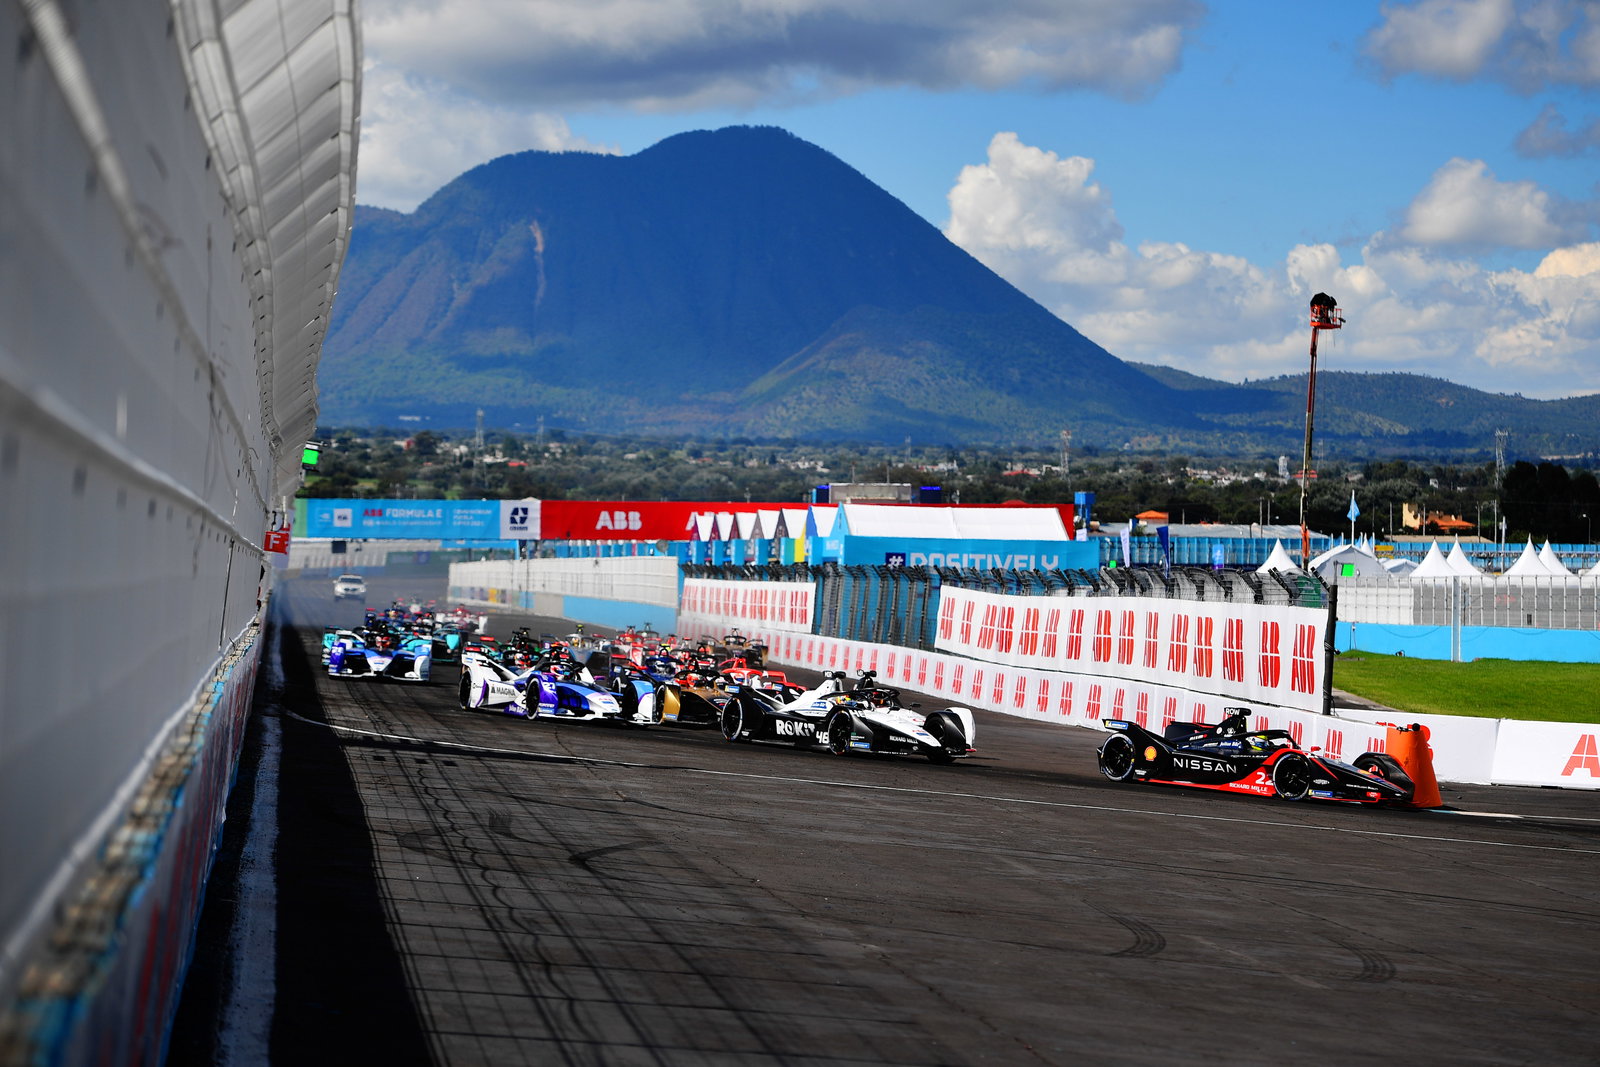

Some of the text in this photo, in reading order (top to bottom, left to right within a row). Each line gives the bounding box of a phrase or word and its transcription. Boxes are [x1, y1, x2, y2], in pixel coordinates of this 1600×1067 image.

[385, 508, 434, 518] FORMULA
[436, 509, 443, 518] E
[595, 510, 643, 530] ABB
[1291, 624, 1316, 695] ABB
[496, 686, 516, 696] MAGNA
[1085, 684, 1102, 721] ABB
[1226, 708, 1241, 716] ROW
[1173, 757, 1238, 774] NISSAN
[1229, 782, 1250, 790] RICHARD
